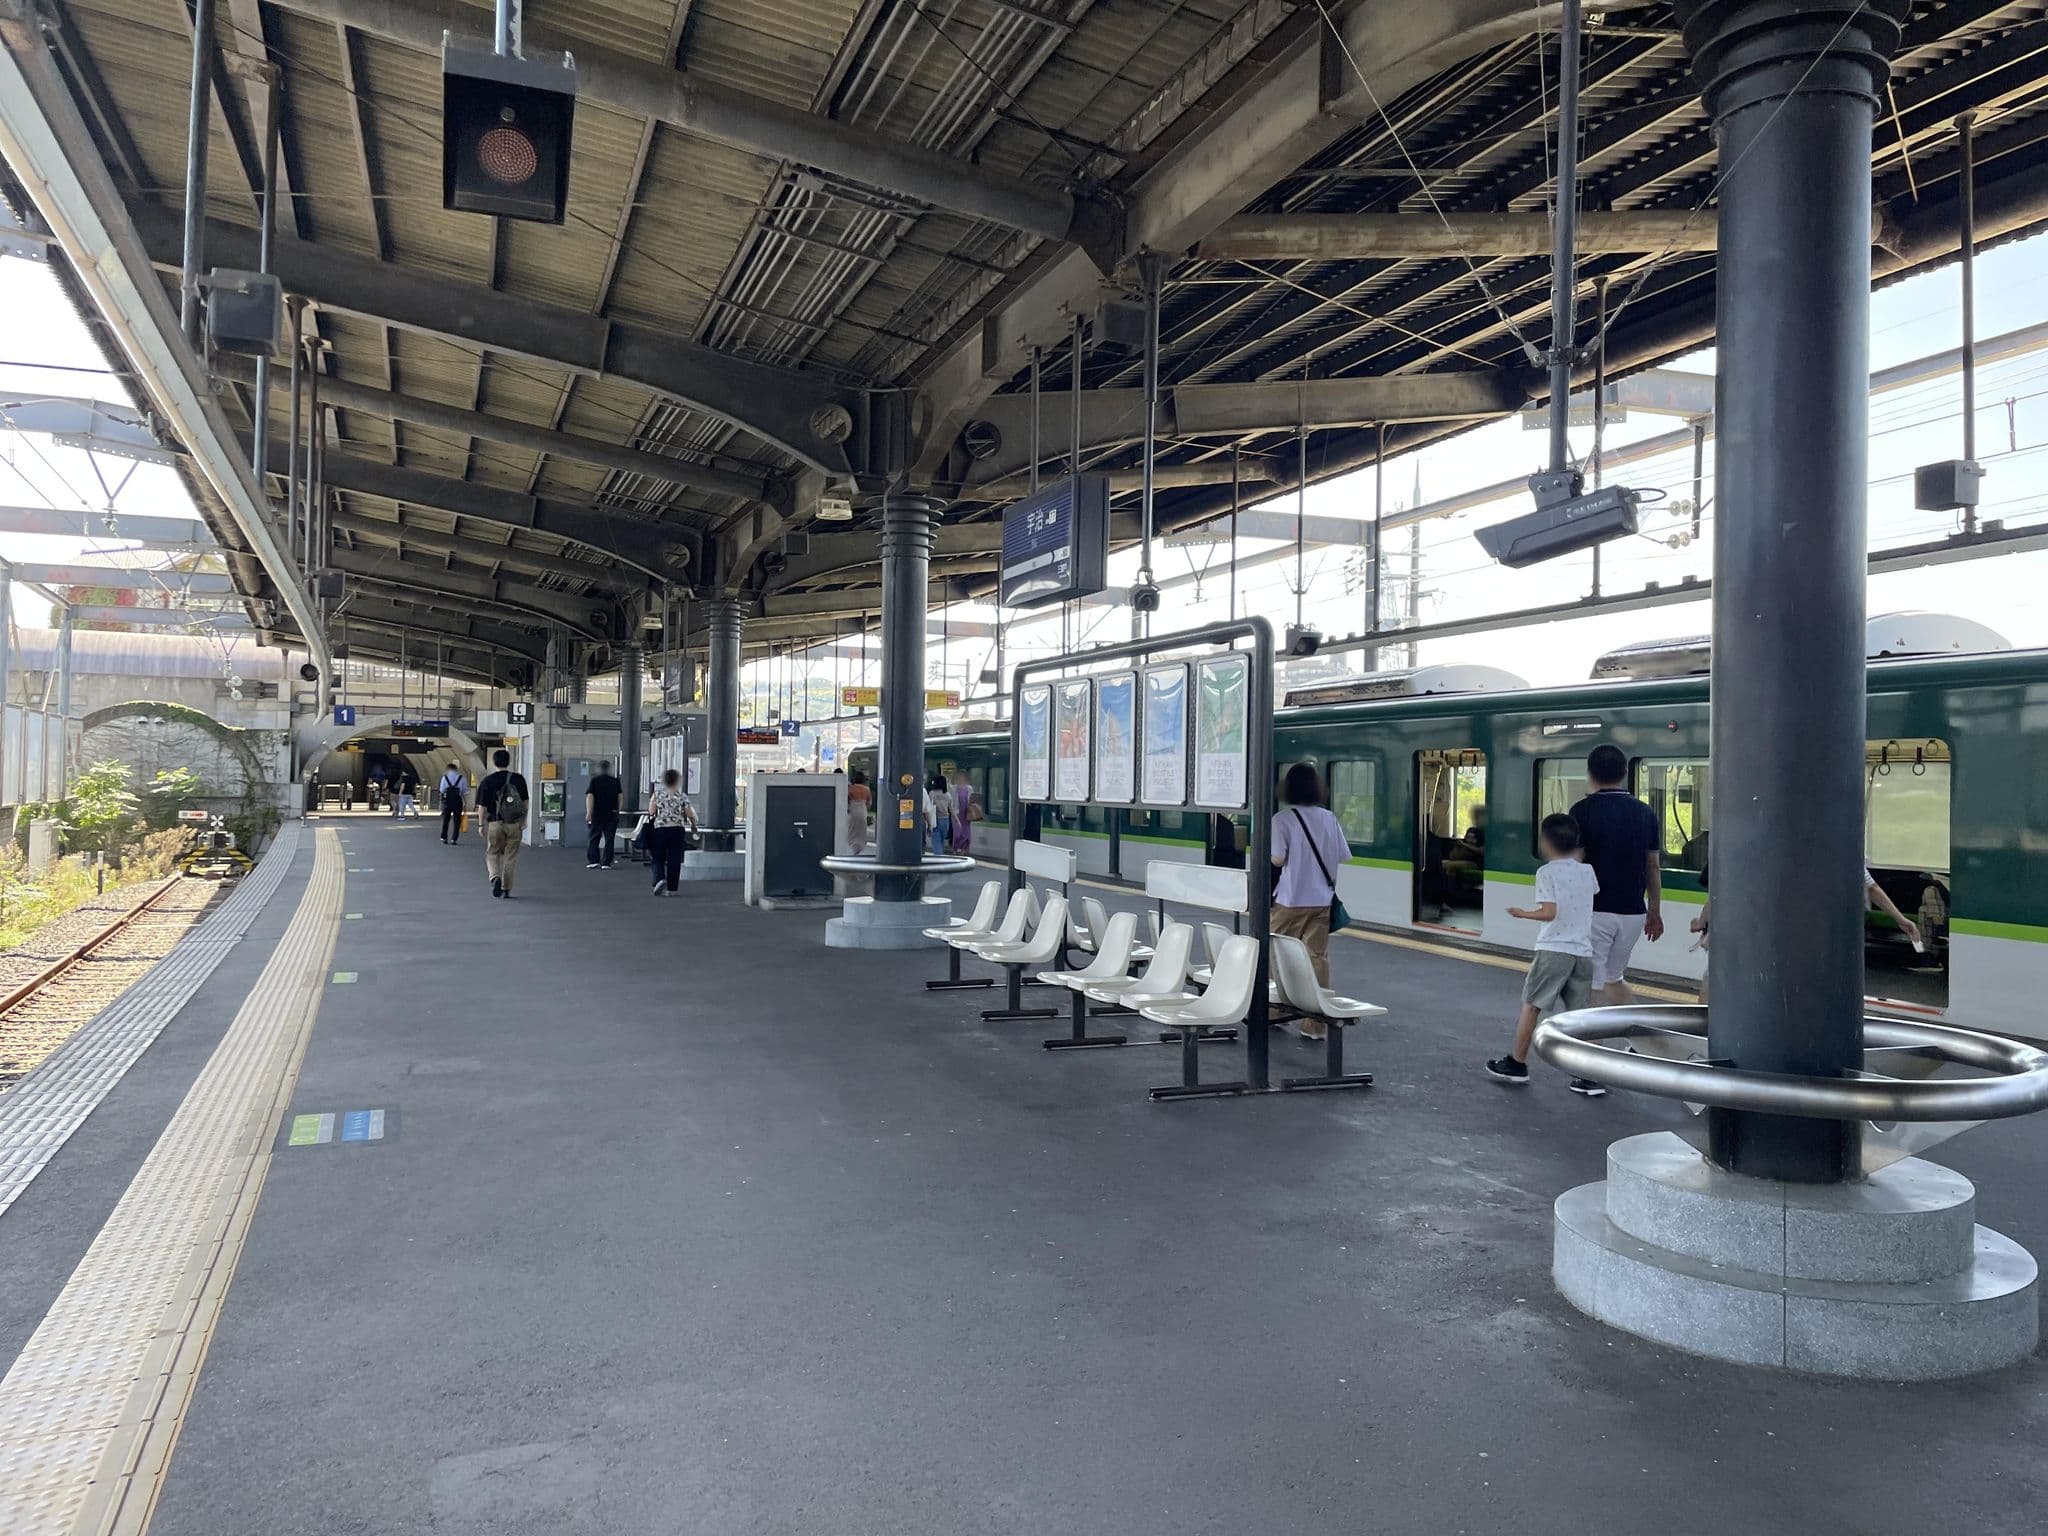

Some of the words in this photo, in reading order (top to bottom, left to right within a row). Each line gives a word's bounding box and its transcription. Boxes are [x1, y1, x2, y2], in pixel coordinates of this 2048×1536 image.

[1026, 508, 1043, 535] 宇治
[340, 709, 348, 722] 1
[787, 722, 795, 733] 2
